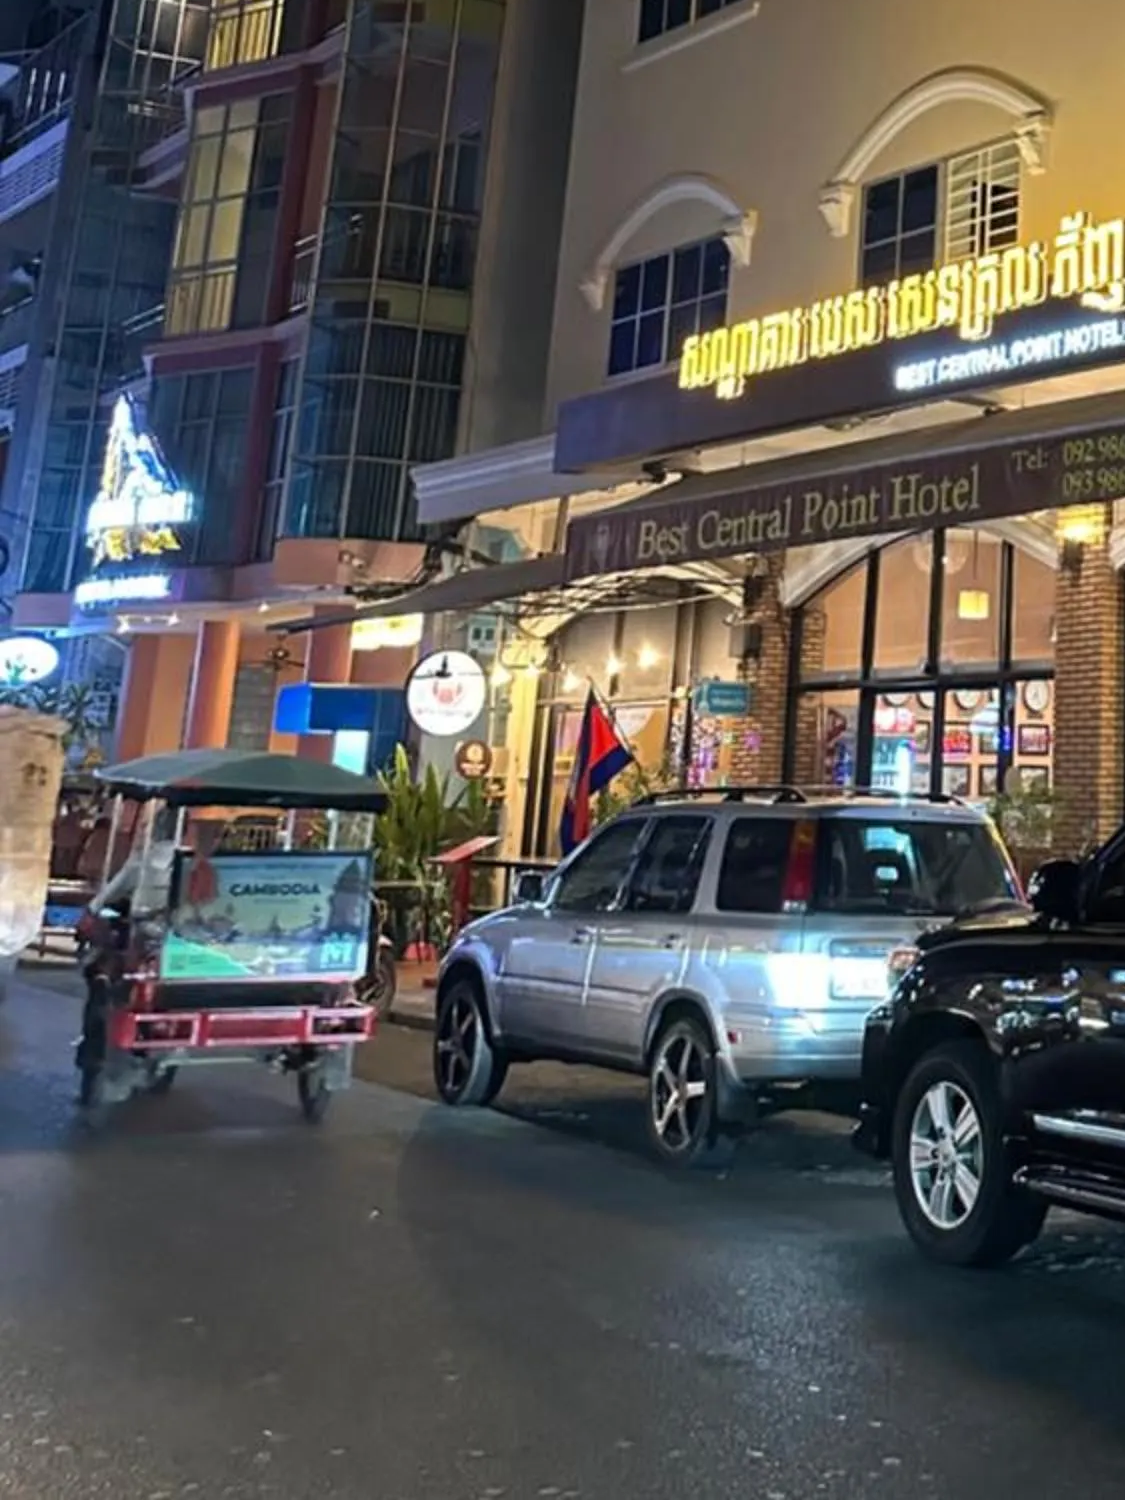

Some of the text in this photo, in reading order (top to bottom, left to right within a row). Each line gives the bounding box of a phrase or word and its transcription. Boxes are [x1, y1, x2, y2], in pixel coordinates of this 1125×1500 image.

[1010, 331, 1062, 366] POINT
[1062, 438, 1096, 468] 092
[1062, 469, 1095, 497] 093
[638, 462, 980, 560] Best Central Point Hotel
[229, 883, 321, 897] CAMBODIA
